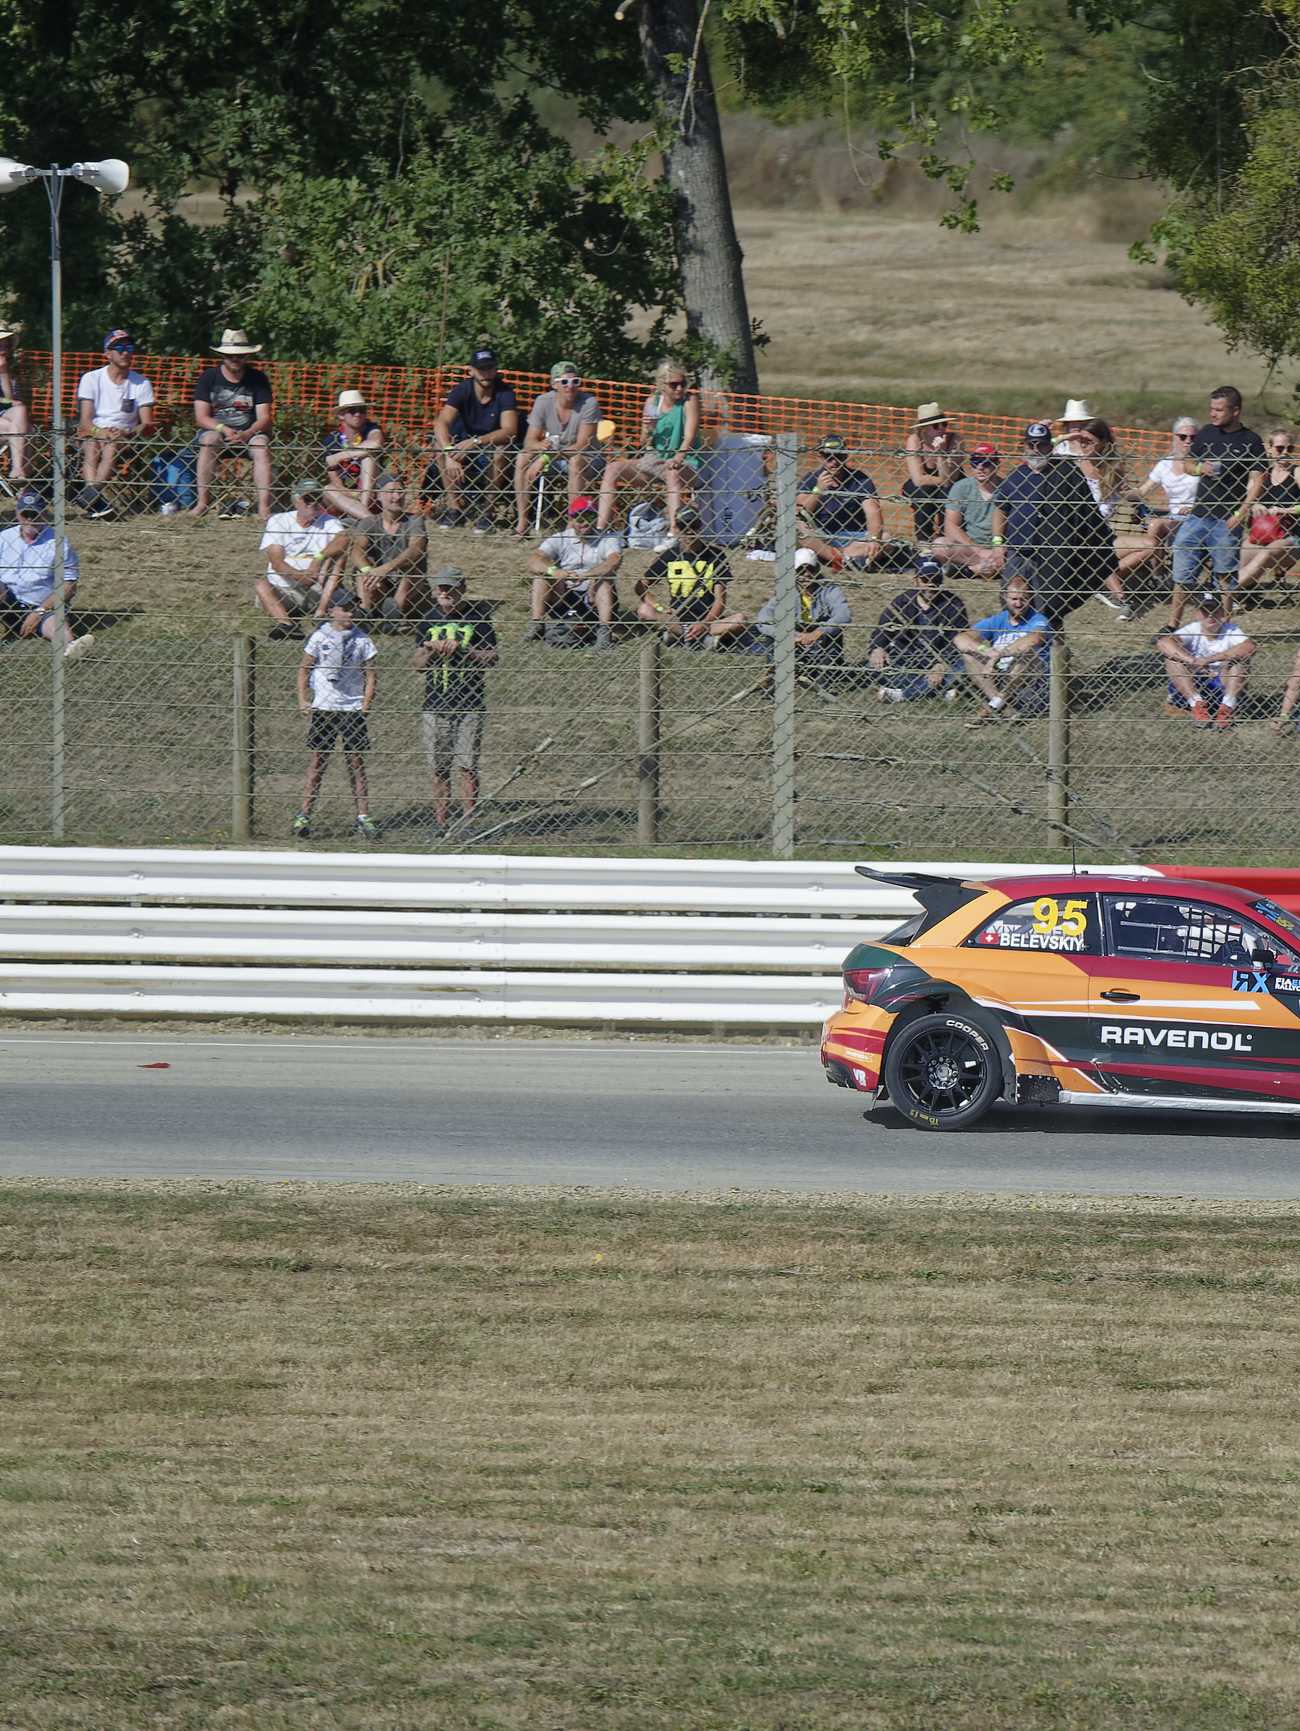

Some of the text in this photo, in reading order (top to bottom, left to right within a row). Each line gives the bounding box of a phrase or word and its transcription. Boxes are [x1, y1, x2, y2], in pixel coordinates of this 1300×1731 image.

[1032, 897, 1088, 937] 95
[1000, 932, 1084, 952] BELEVSKIY
[945, 1019, 990, 1051] COOPER
[1100, 1025, 1253, 1052] RAVENOL
